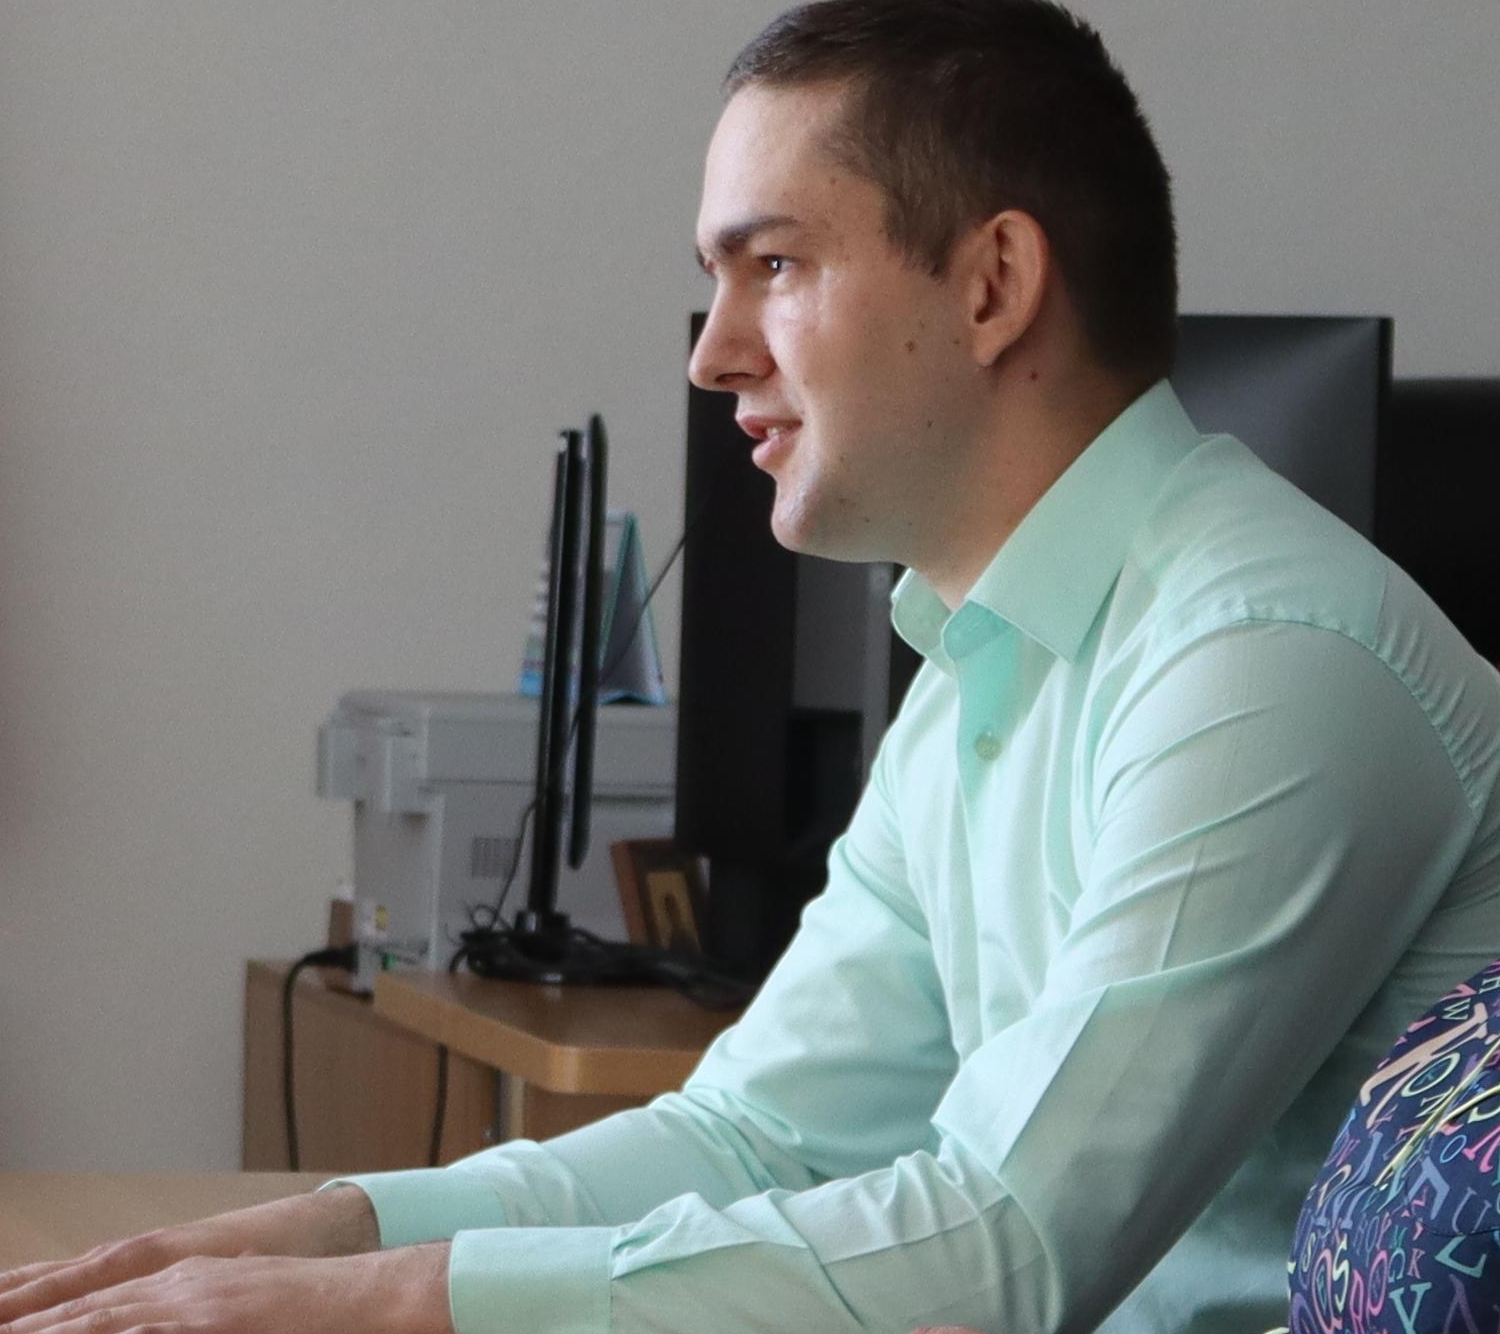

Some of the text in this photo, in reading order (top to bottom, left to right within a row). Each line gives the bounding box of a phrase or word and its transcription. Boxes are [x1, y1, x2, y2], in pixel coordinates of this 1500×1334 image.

[1440, 1135, 1467, 1163] O
[1332, 1233, 1350, 1313] S
[1407, 1248, 1426, 1279] K
